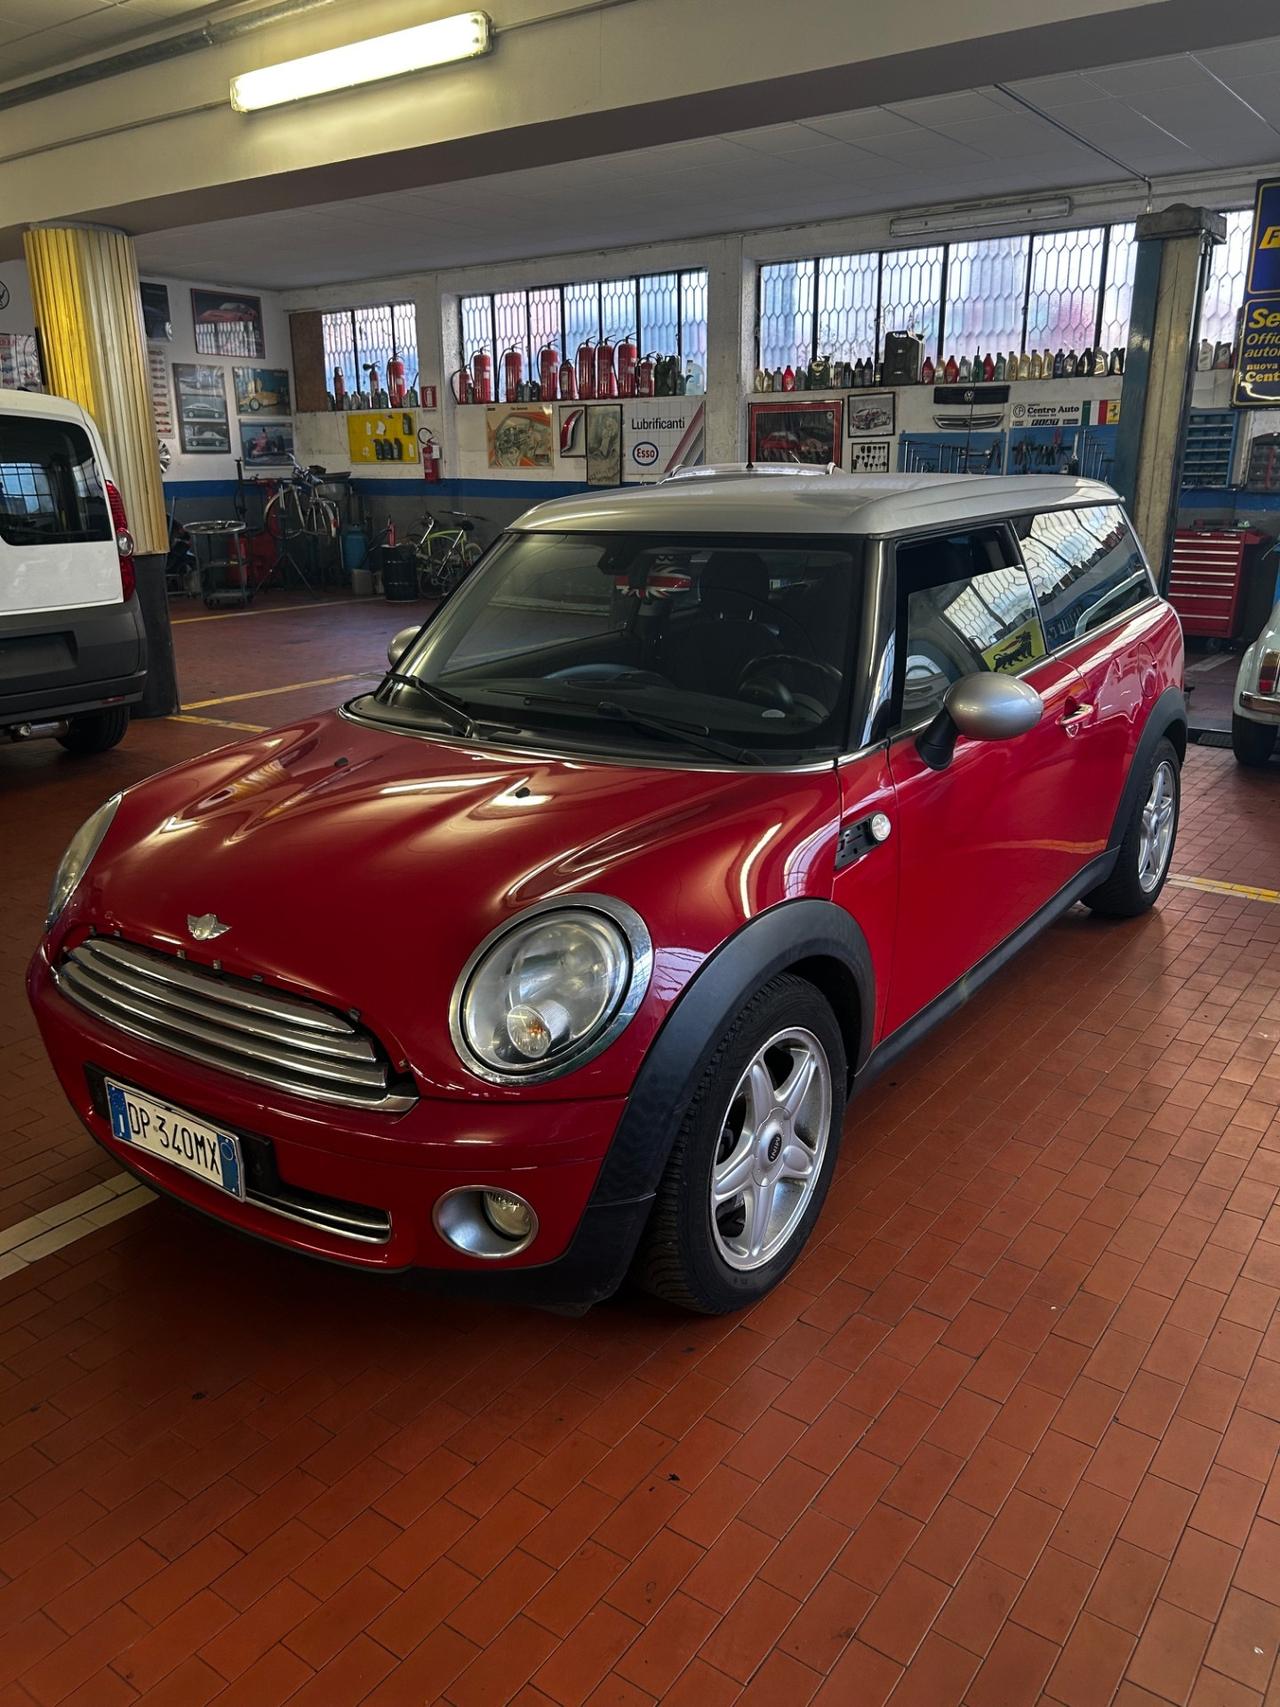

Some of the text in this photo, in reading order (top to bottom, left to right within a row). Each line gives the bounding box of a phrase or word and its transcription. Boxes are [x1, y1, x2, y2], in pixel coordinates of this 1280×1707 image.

[1246, 362, 1278, 370] nuova
[1058, 405, 1080, 413] Auto
[631, 417, 685, 430] Lubrificanti
[636, 447, 655, 458] Esso
[769, 1135, 781, 1160] MINI
